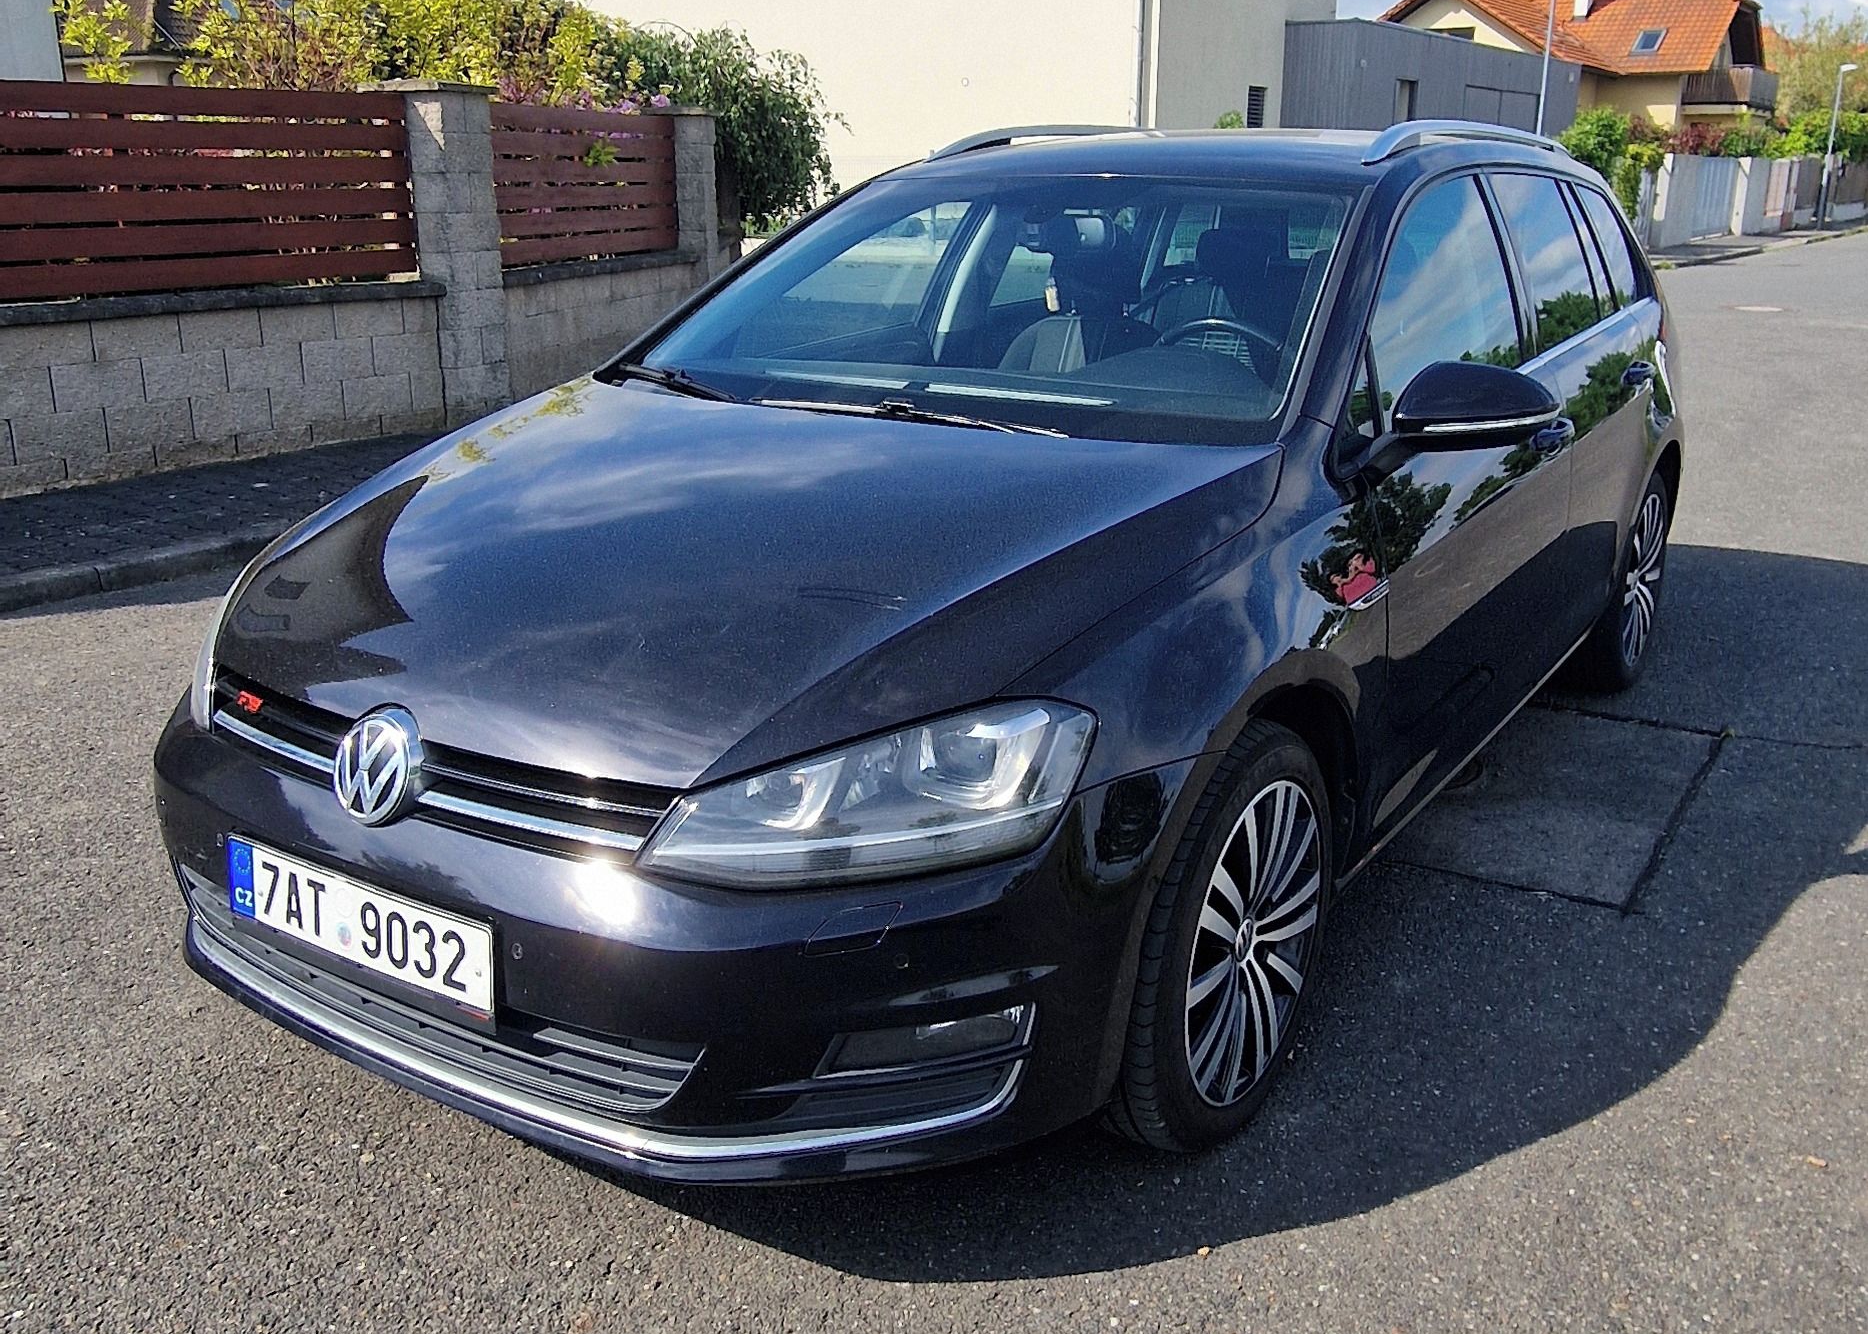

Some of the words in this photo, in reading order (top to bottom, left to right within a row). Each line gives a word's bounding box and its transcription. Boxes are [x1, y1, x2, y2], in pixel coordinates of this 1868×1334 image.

[336, 715, 409, 824] VW
[234, 886, 254, 908] CZ
[261, 860, 327, 937] 7AT
[360, 901, 467, 994] 9032
